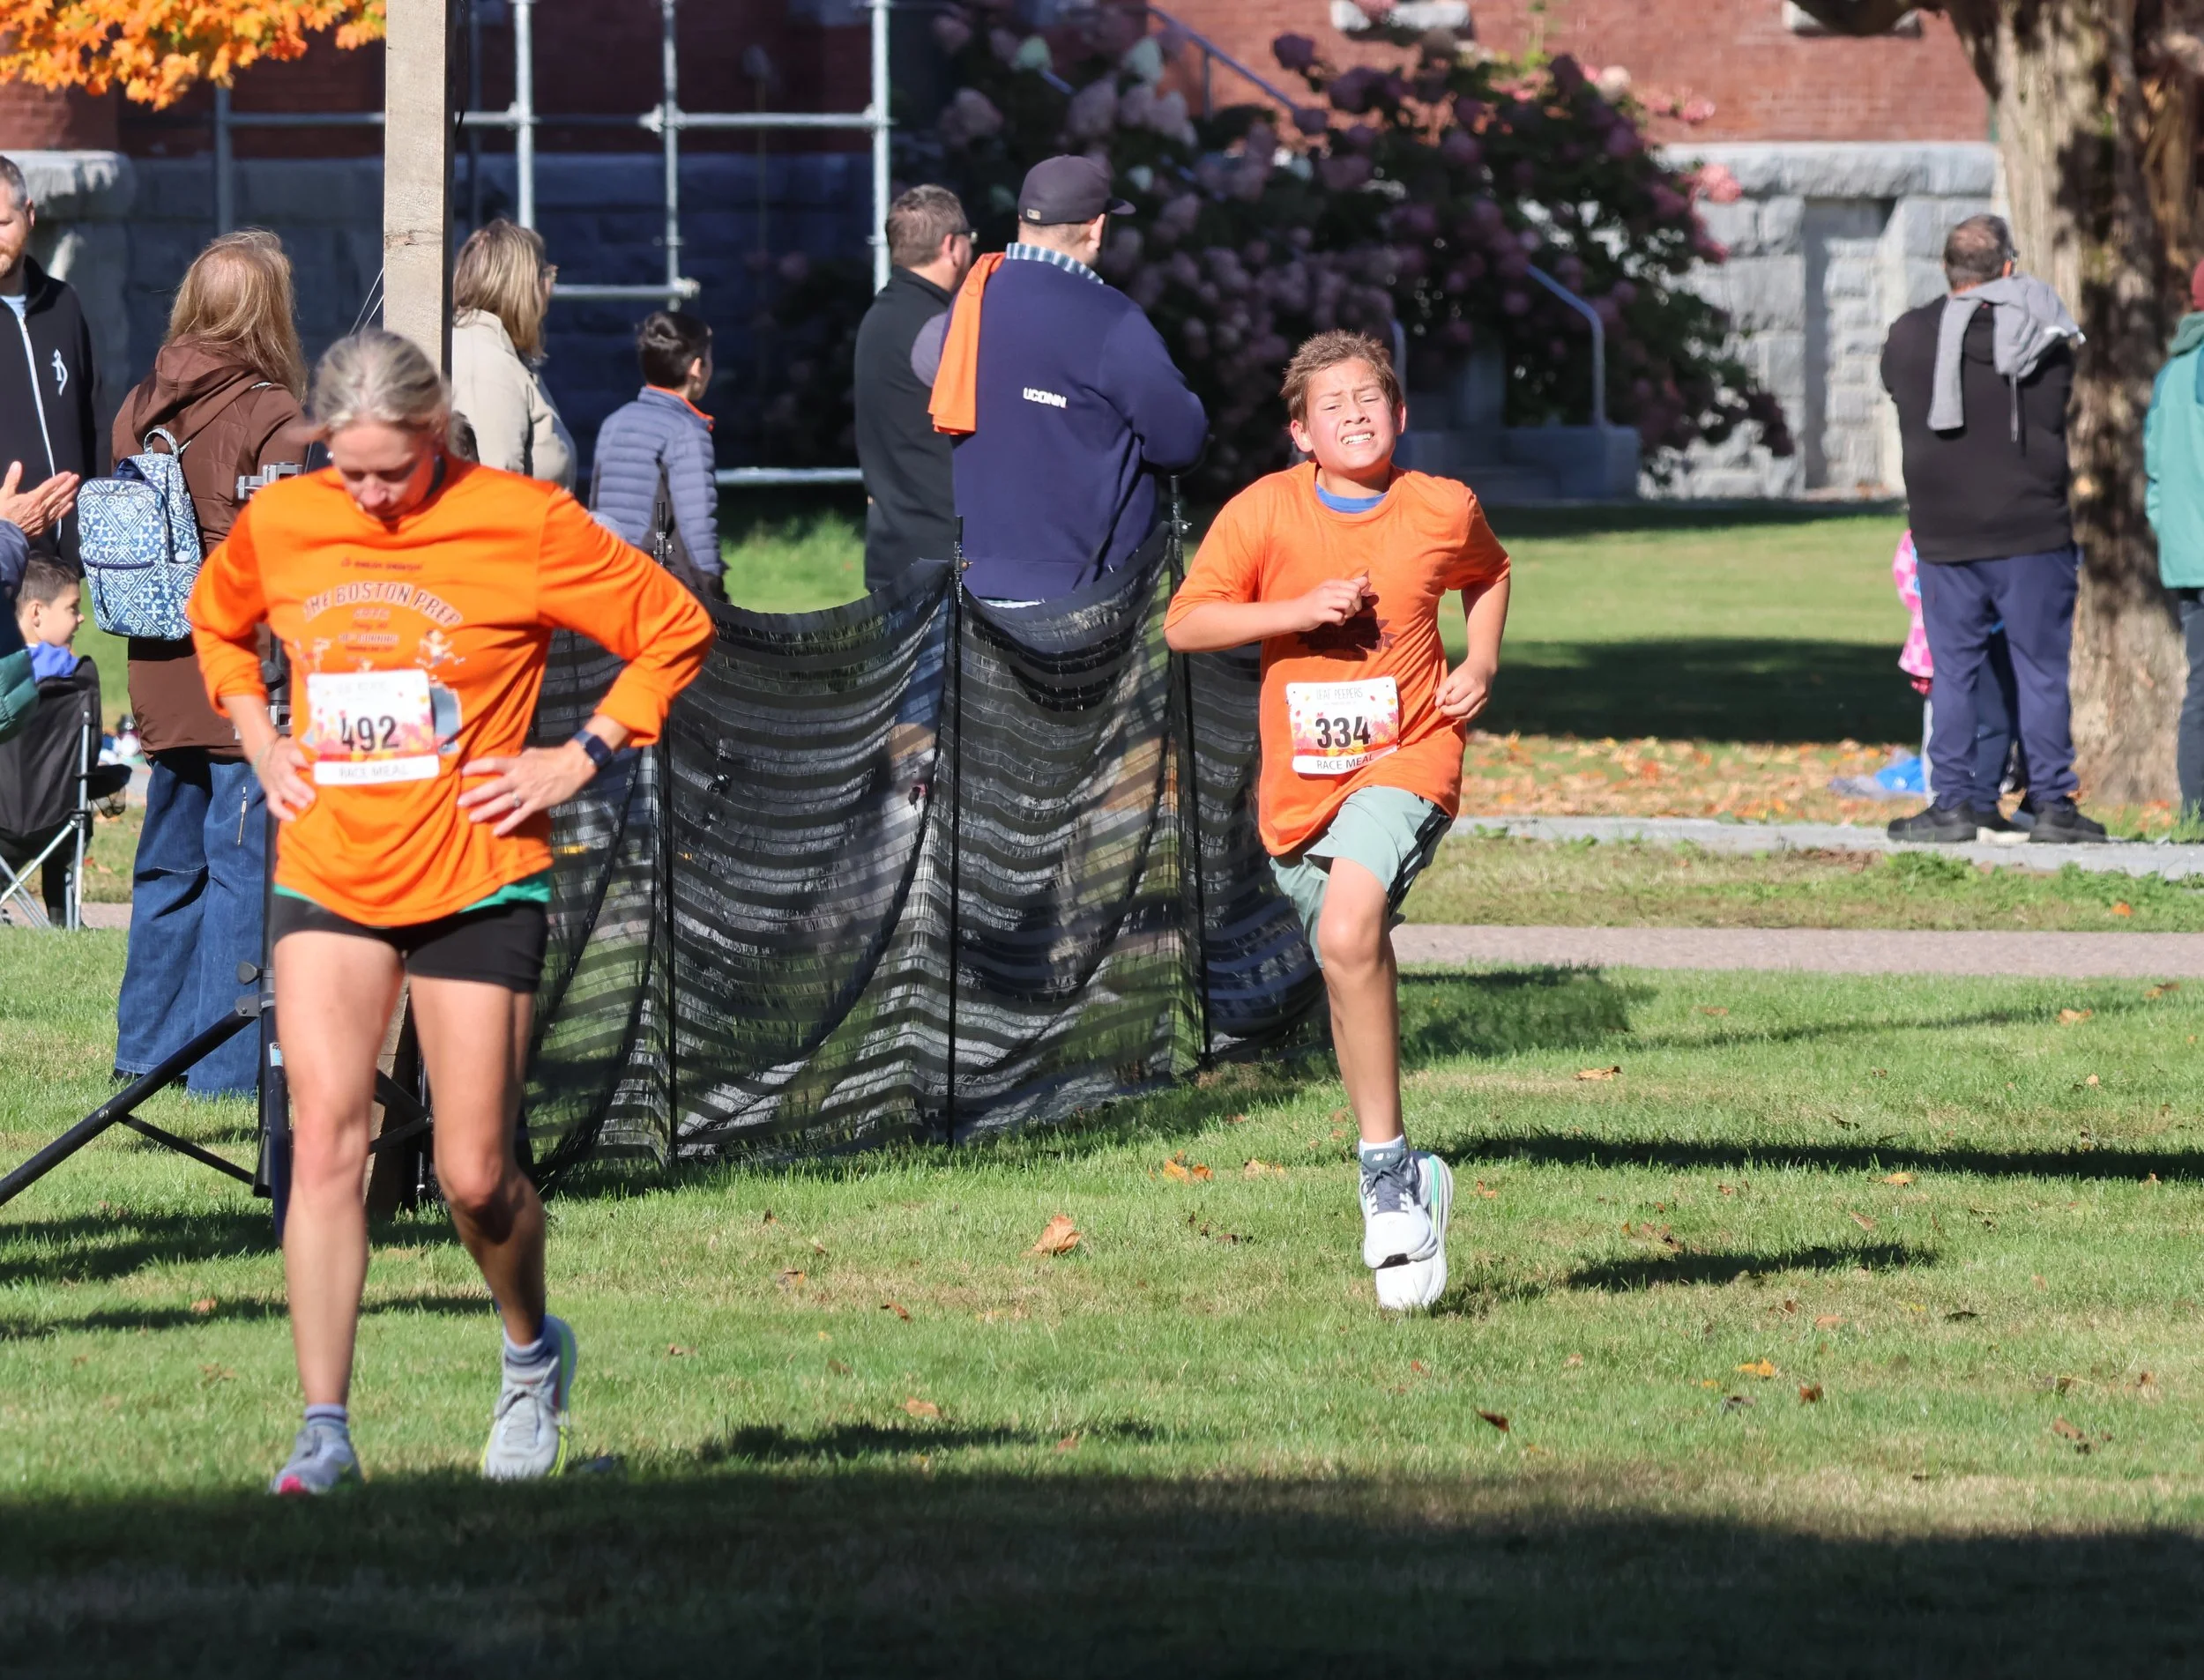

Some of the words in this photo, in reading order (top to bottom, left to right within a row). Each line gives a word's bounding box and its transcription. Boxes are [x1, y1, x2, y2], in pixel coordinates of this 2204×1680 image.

[1023, 387, 1067, 408] UCONN
[304, 594, 331, 620] THE
[336, 582, 412, 606] BOSTON
[412, 591, 462, 625] PREP
[1334, 688, 1363, 700] PEEPERS
[341, 716, 399, 752] 492
[1315, 716, 1371, 748] 334
[371, 763, 409, 777] MEAL
[1316, 760, 1343, 770] RACE
[1345, 754, 1374, 769] MEAL
